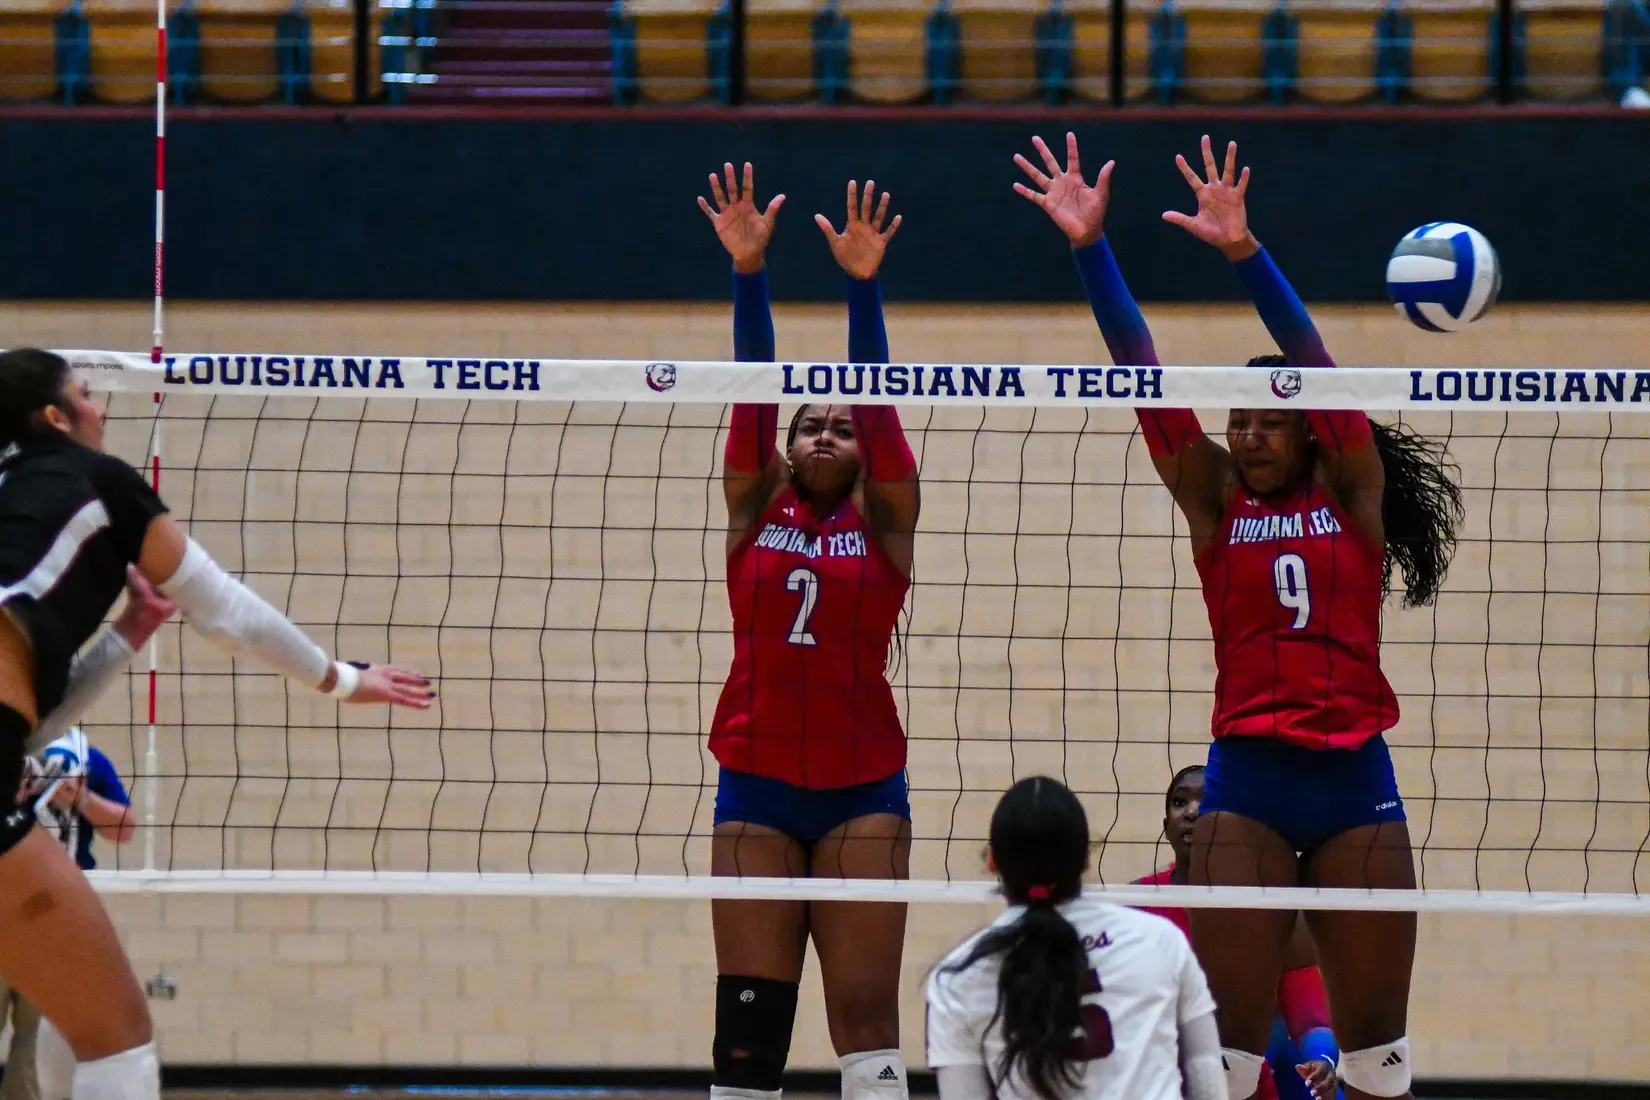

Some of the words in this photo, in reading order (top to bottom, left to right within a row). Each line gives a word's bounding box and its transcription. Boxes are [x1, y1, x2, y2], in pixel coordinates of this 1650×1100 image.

[163, 356, 405, 389] LOUISIANA
[427, 361, 540, 390] TECH
[782, 364, 1026, 397] LOUISIANA
[1046, 367, 1163, 399] TECH
[1409, 370, 1650, 403] LOUISIANA
[786, 567, 818, 645] 2
[1274, 552, 1310, 630] 9
